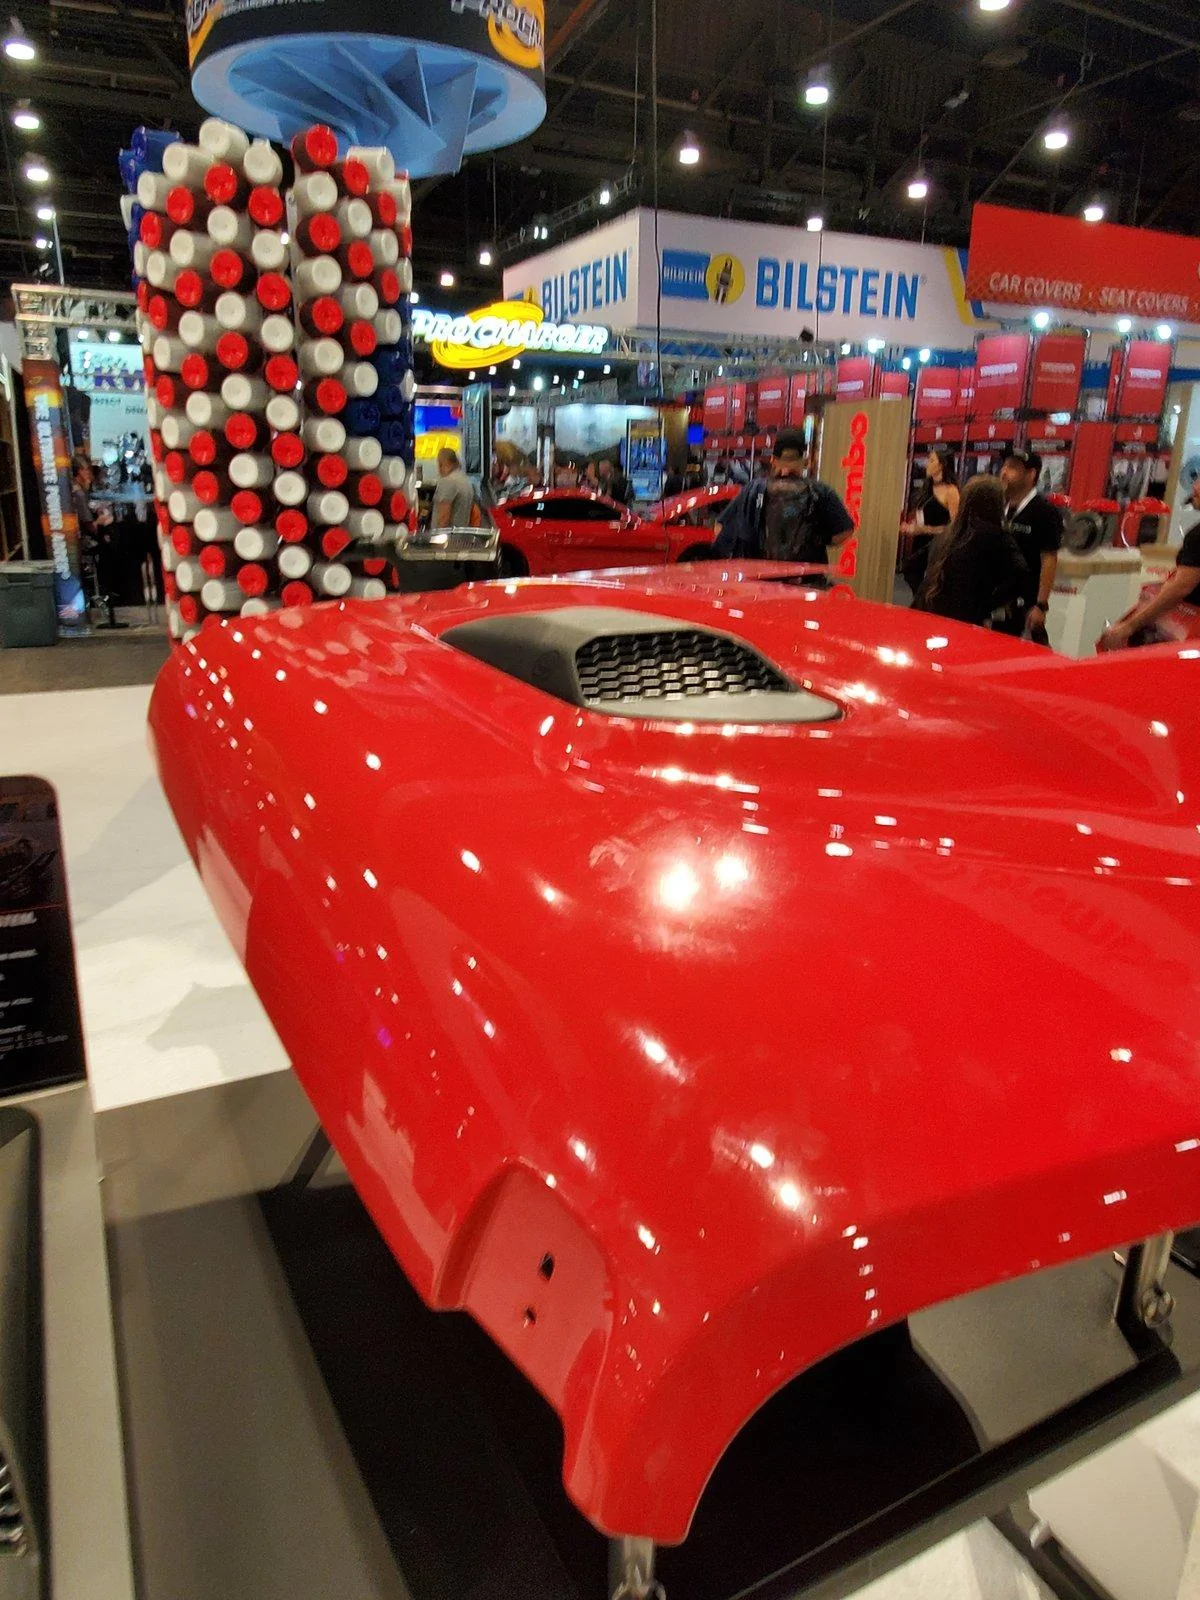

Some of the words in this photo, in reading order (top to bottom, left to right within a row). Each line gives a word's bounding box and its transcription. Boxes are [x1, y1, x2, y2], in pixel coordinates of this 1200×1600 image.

[542, 251, 628, 323] BILSTEIN
[755, 256, 919, 321] BILSTEIN
[989, 271, 1021, 294] CAR
[1024, 276, 1082, 302] COVERS
[1100, 286, 1136, 308] SEAT
[1137, 290, 1189, 314] COVERS
